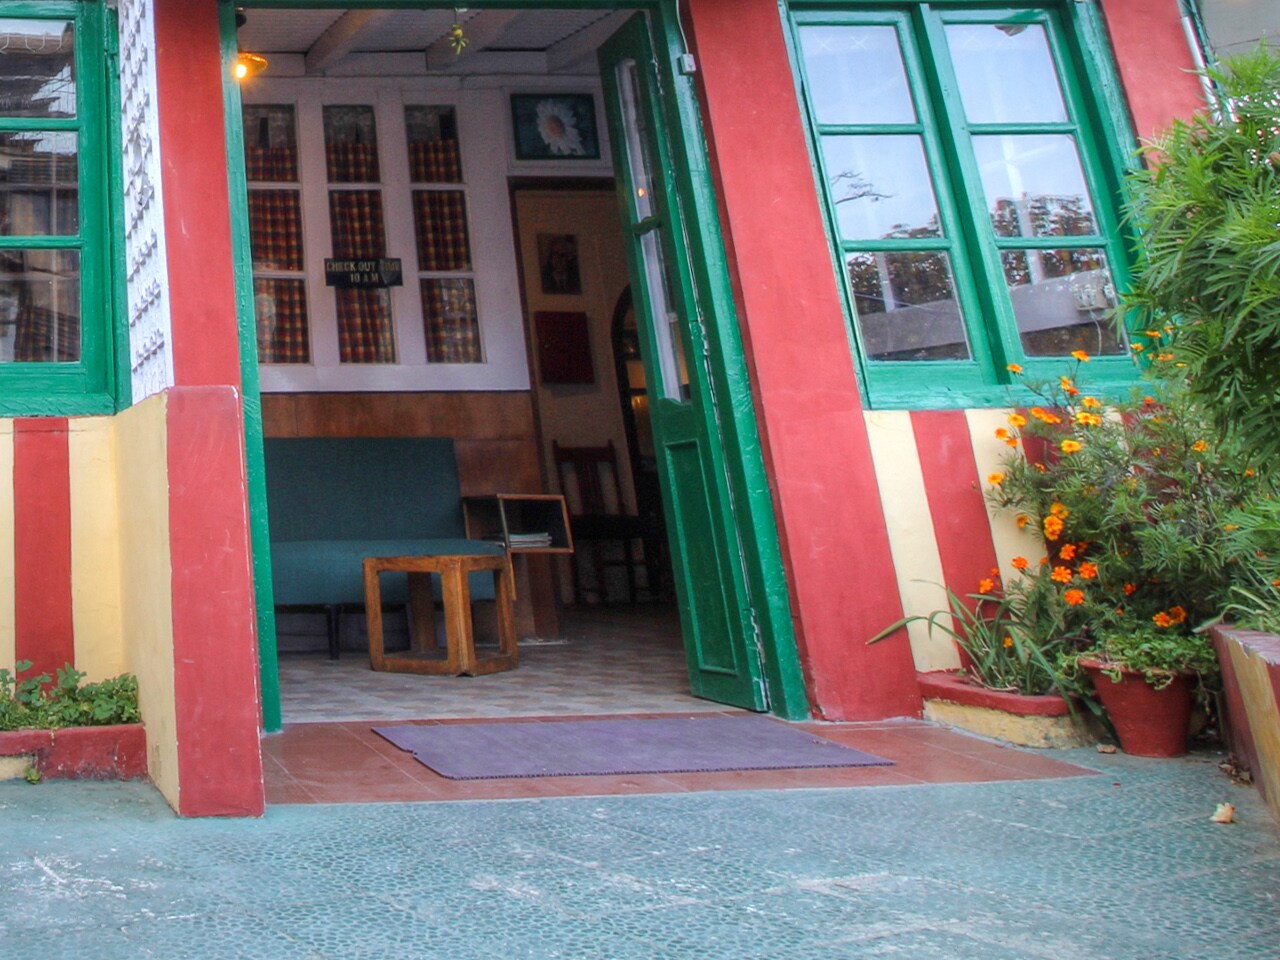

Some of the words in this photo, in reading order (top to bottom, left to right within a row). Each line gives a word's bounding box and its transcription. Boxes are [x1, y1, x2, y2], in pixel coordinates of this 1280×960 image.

[326, 261, 356, 272] CHECK
[358, 261, 376, 272] OUT
[350, 272, 360, 283] 10
